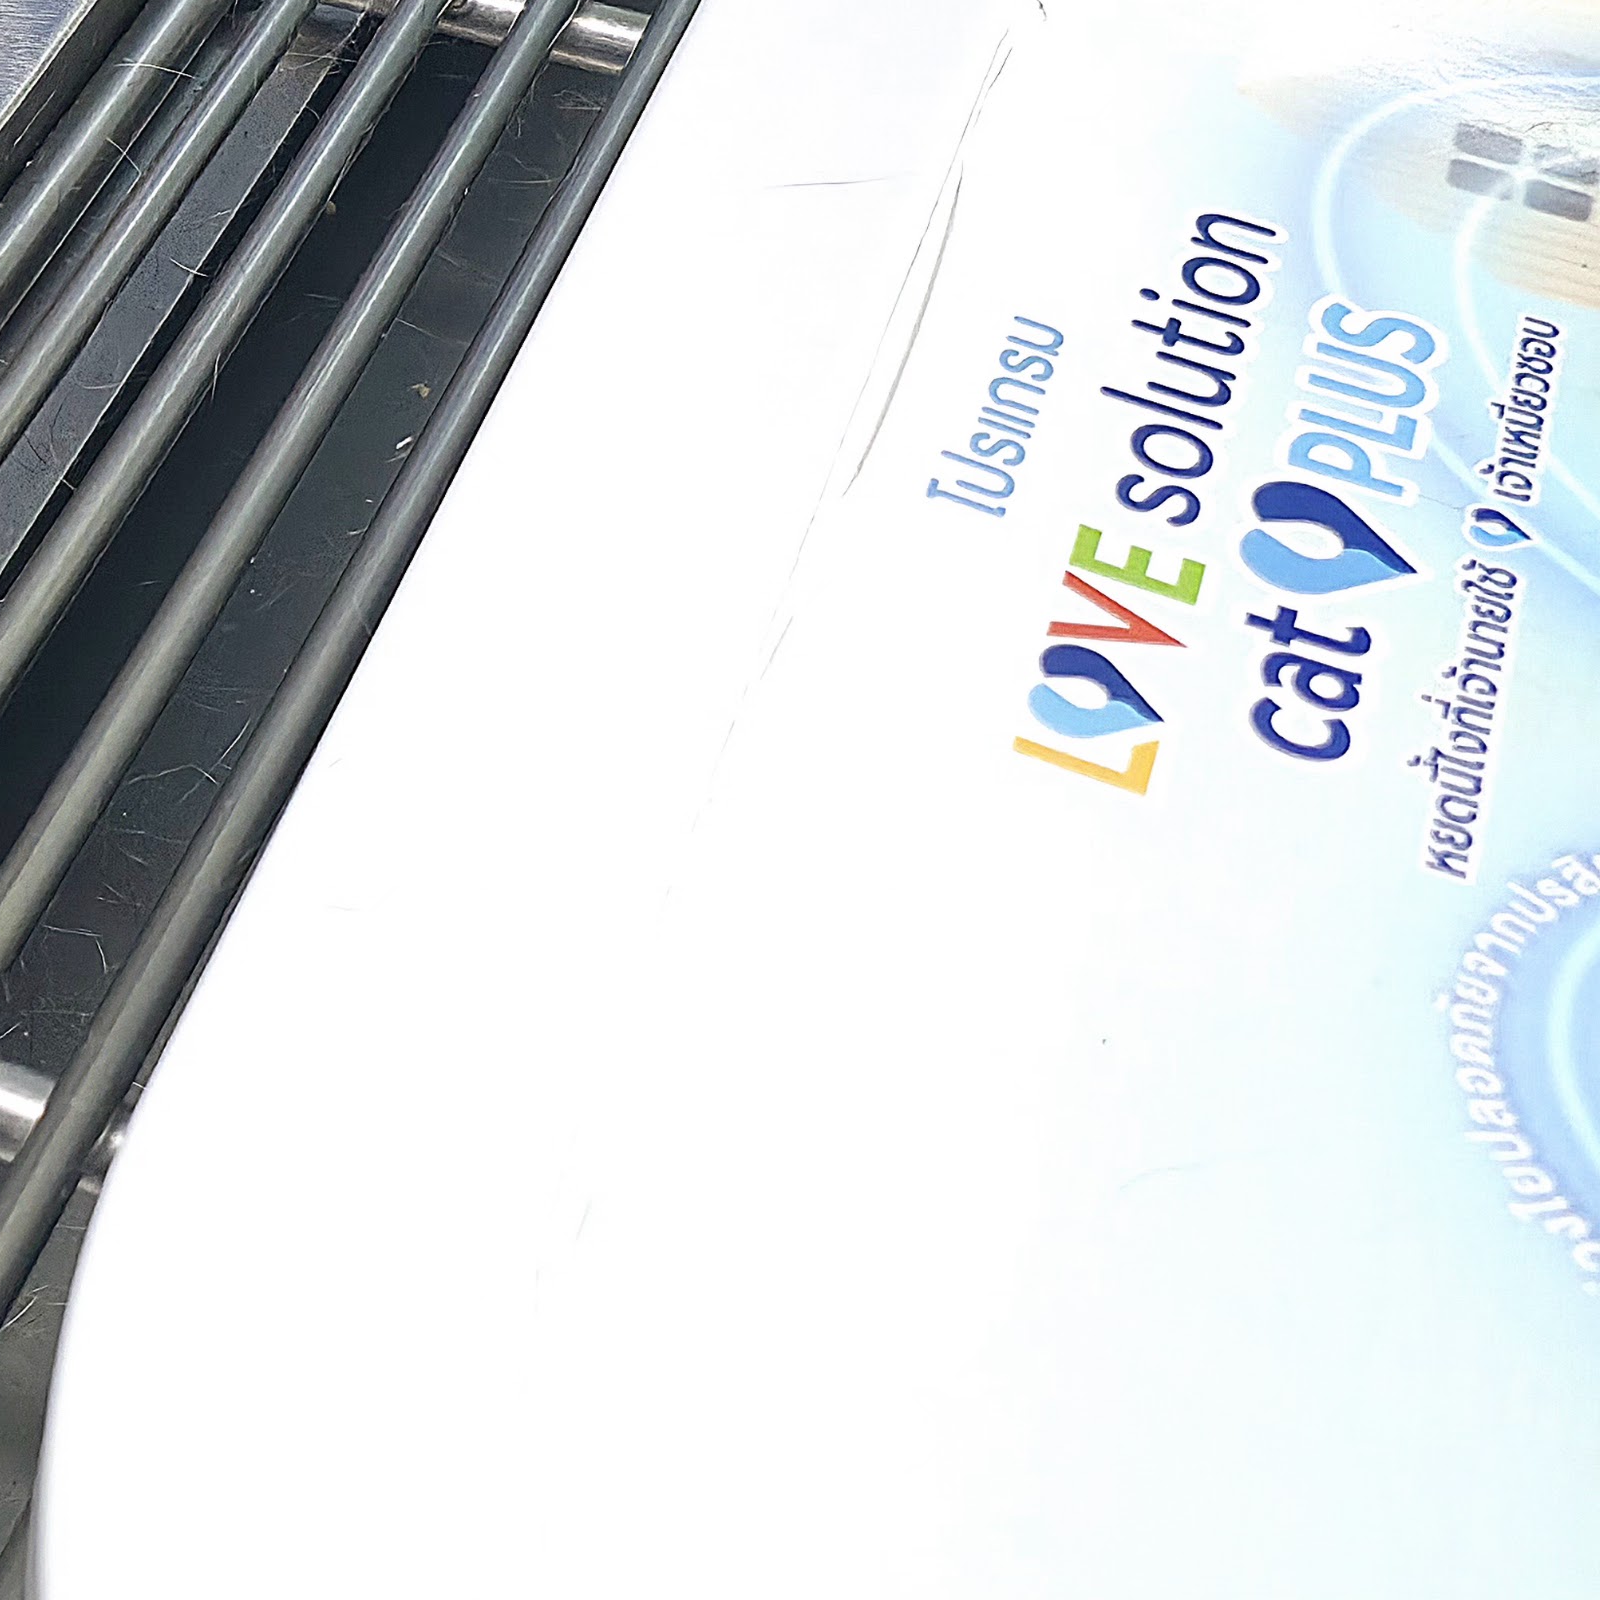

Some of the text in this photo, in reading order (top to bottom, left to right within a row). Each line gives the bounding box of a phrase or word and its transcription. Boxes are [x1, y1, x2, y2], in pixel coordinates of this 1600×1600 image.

[927, 317, 1066, 516] โปรแกรม
[1101, 211, 1277, 525] solution
[1244, 303, 1436, 762] cat PLUS
